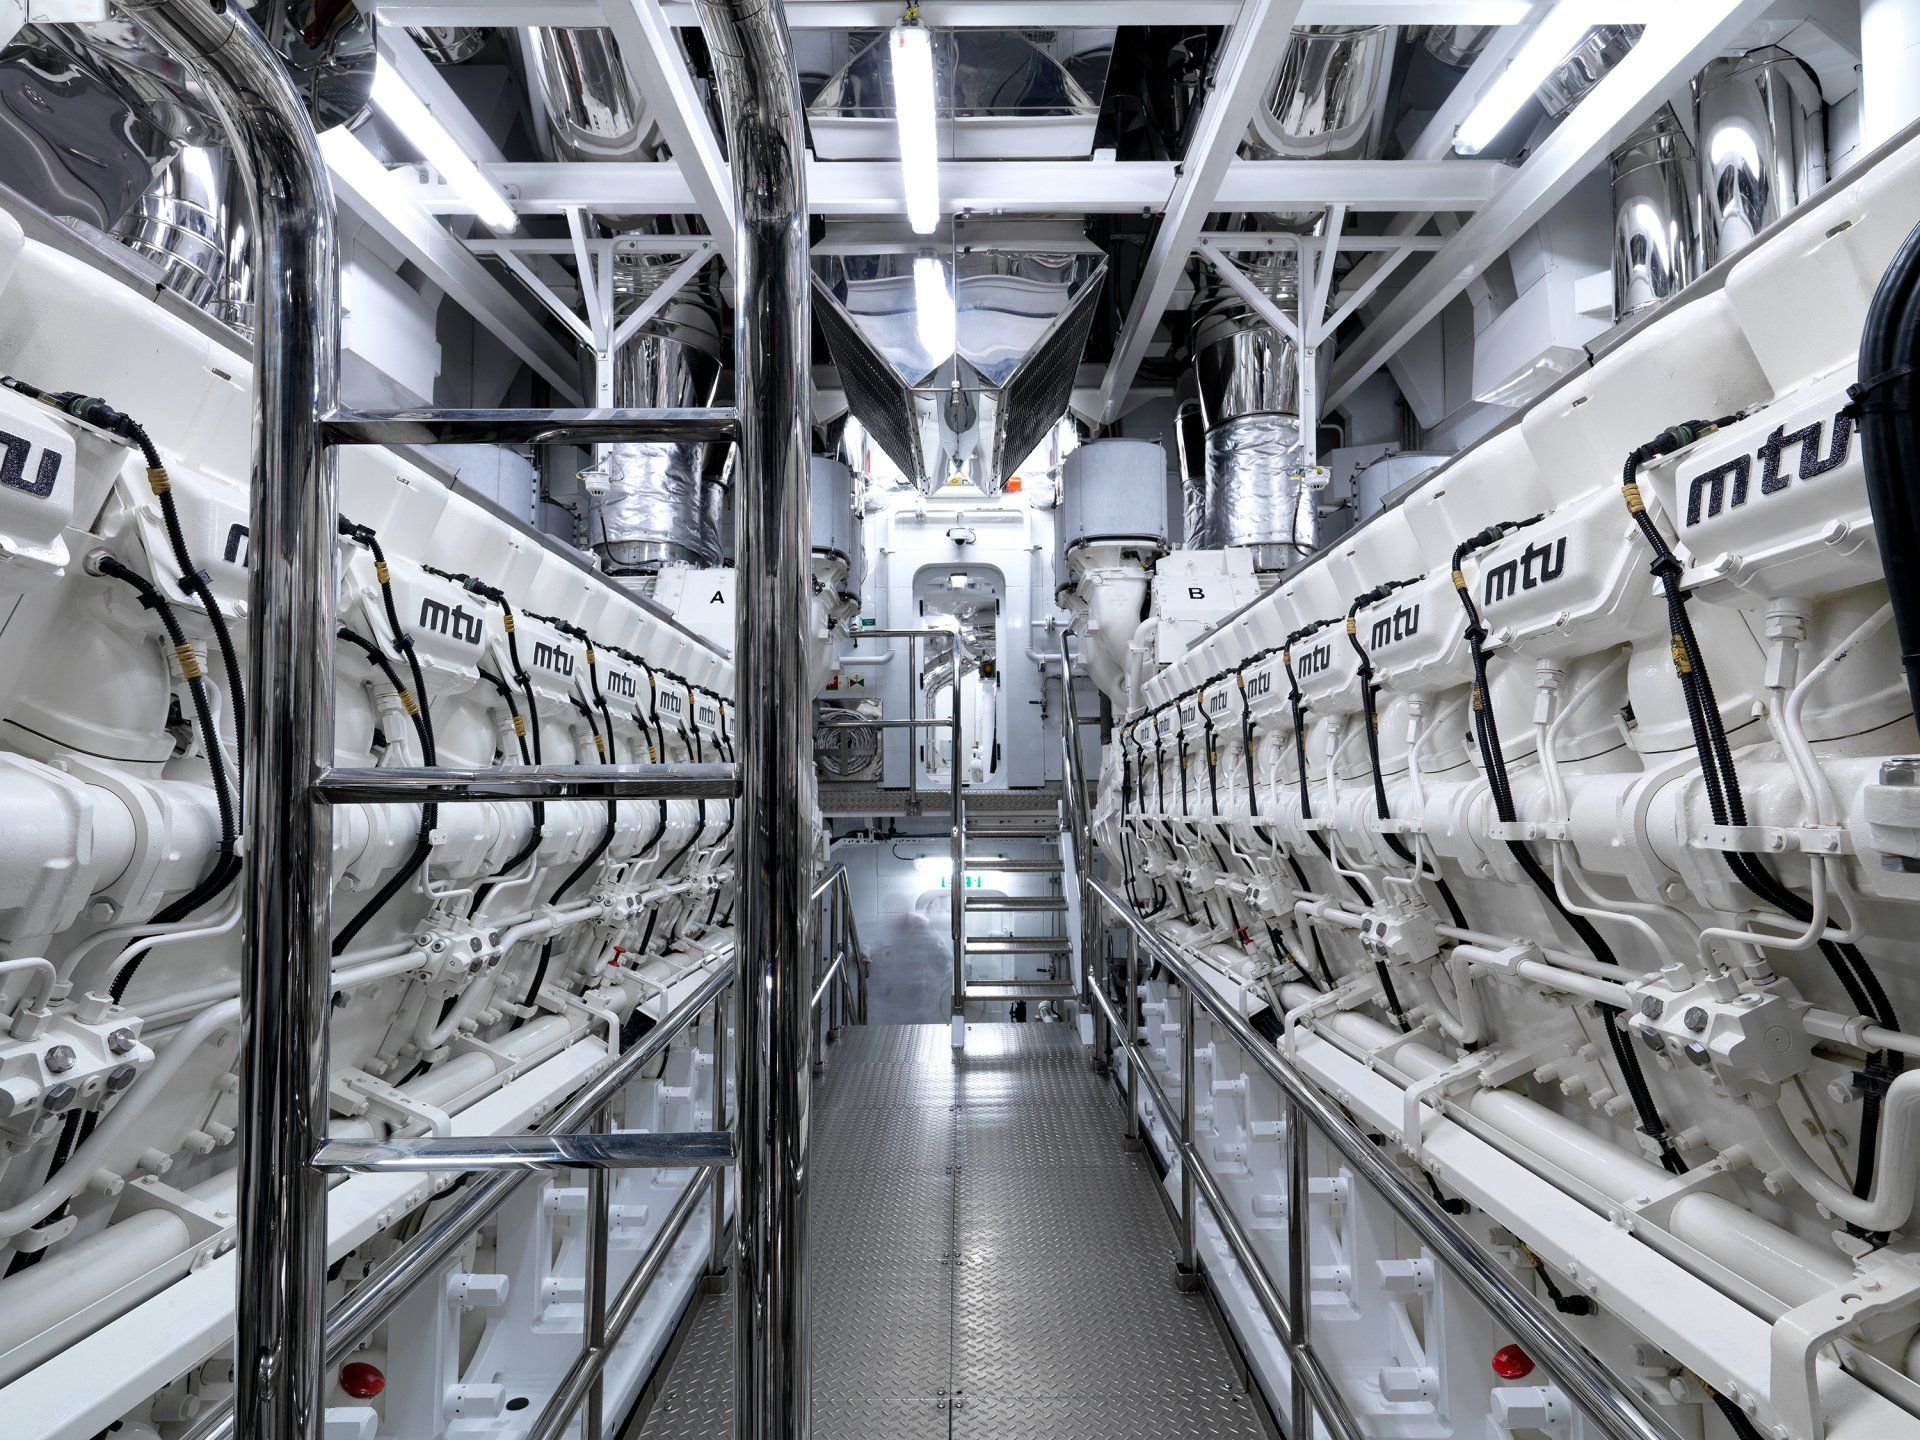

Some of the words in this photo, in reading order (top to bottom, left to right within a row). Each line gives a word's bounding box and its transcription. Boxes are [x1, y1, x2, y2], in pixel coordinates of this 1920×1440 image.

[1686, 411, 1852, 528] mtu
[1484, 537, 1567, 606] mtu
[710, 590, 725, 604] A
[1188, 587, 1205, 600] B
[419, 597, 483, 645] mtu
[1371, 603, 1420, 650] mtu
[533, 641, 574, 676] mtu
[1299, 644, 1331, 679] mtu
[607, 670, 636, 698] mtu
[1248, 670, 1271, 699] mtu
[660, 690, 681, 713] mtu
[699, 705, 716, 725] mtu
[1181, 705, 1196, 726] mtu
[1211, 690, 1228, 713] mtu
